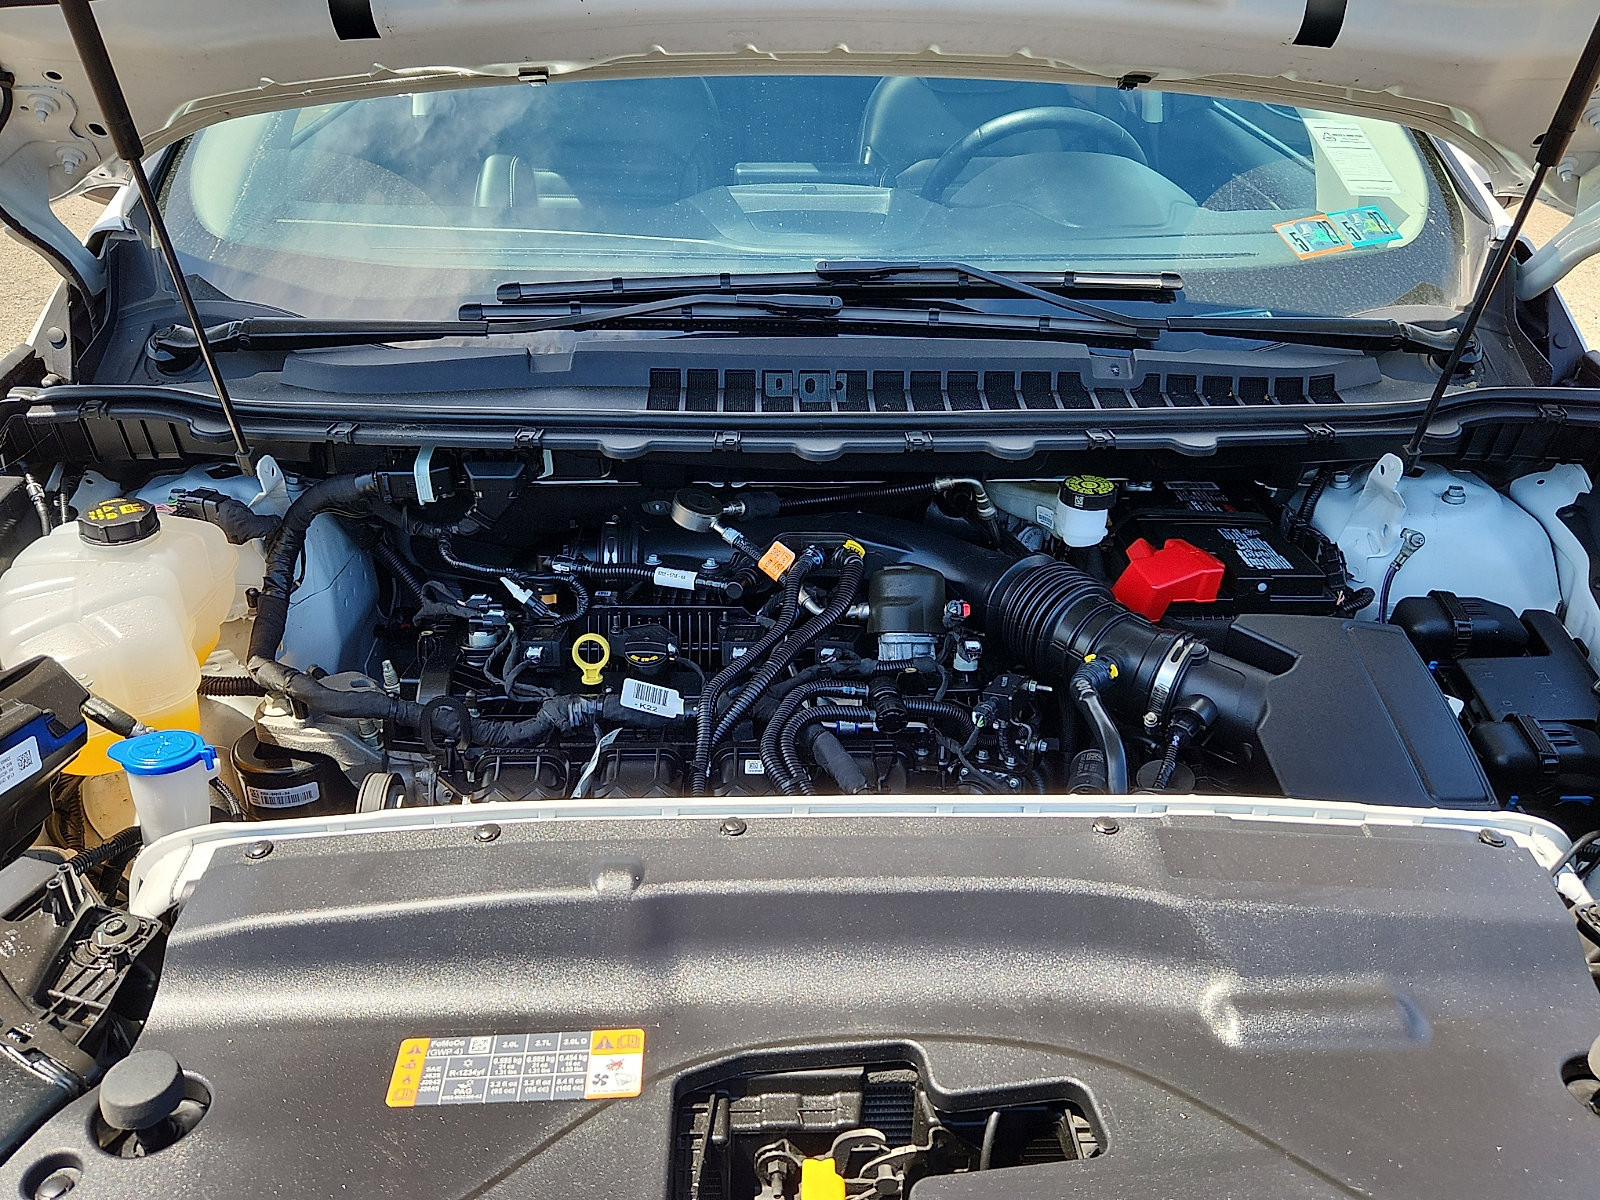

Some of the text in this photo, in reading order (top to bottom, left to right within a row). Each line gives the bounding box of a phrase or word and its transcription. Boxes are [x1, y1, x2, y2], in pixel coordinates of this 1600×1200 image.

[431, 1038, 465, 1048] FoMoCo
[427, 1048, 453, 1057] (GWP
[513, 1056, 522, 1065] kg
[546, 1055, 555, 1063] kg
[578, 1054, 587, 1062] kg
